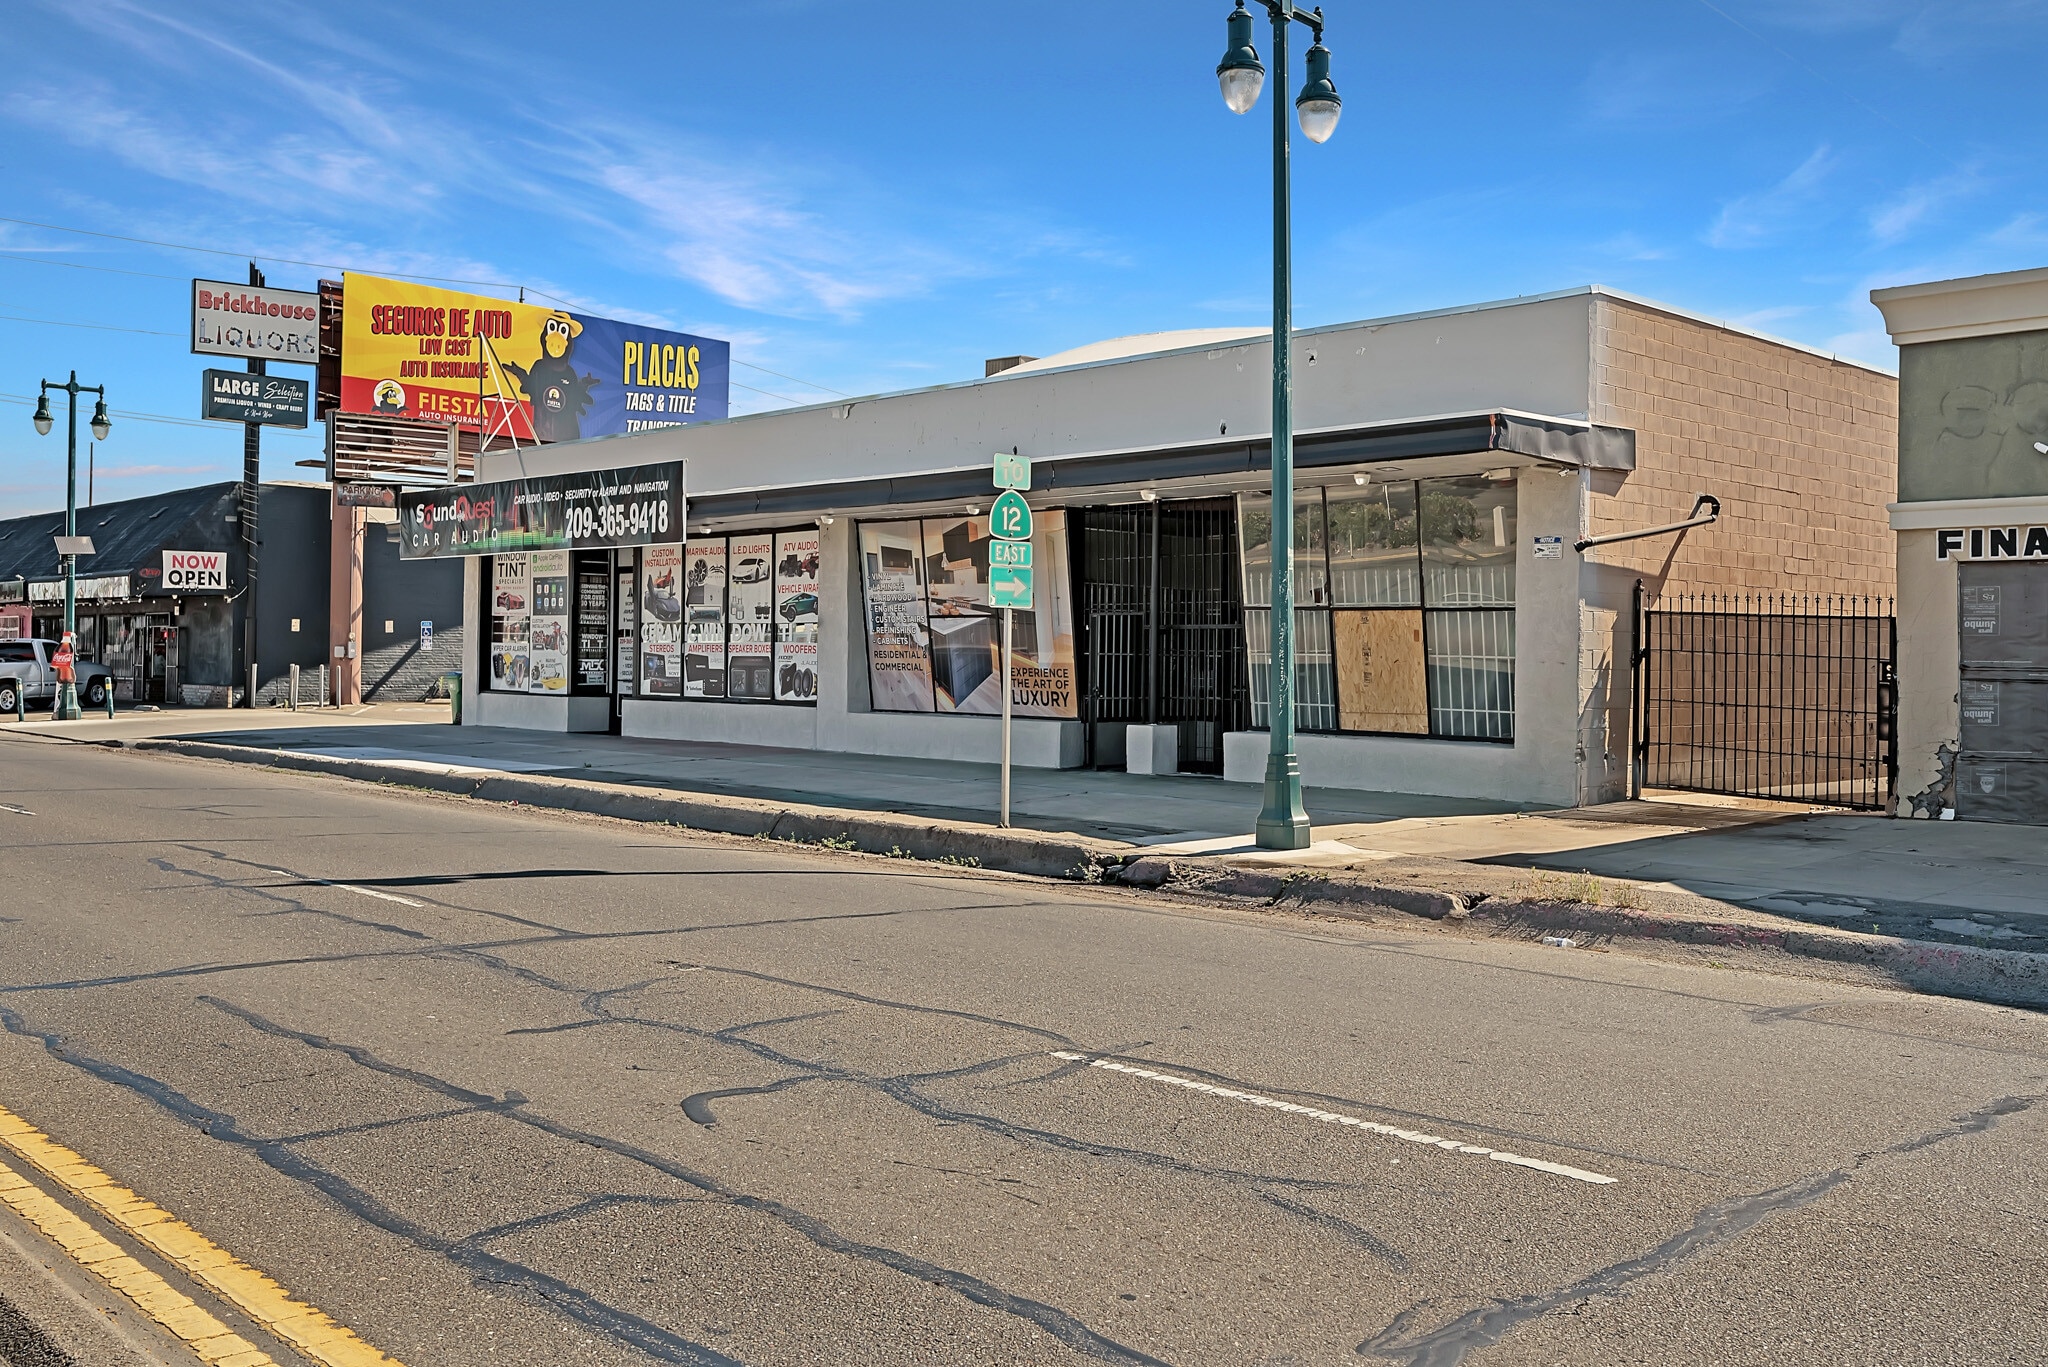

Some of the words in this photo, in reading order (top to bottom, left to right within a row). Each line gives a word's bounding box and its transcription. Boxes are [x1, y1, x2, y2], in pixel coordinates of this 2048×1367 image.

[199, 290, 316, 321] Brickhouse
[371, 305, 445, 336] SEGUROS
[449, 308, 470, 338] DE
[472, 309, 512, 340] AUTO
[199, 318, 316, 354] LIQUORS
[419, 338, 443, 355] LOW
[445, 338, 472, 356] COST
[400, 360, 428, 377] AUTO
[213, 377, 260, 397] LARGE
[263, 381, 304, 403] Selection
[214, 396, 235, 405] PREMIUM
[236, 399, 253, 407] LIQUOR
[275, 403, 289, 411] CRAFT
[418, 392, 489, 417] FIESTA
[626, 392, 654, 412] TAGS
[656, 394, 665, 412] &
[668, 394, 697, 414] TITLE
[419, 410, 441, 420] AUTO
[443, 413, 489, 426] INSURANE
[1001, 461, 1025, 483] TO
[342, 485, 382, 495] PARKING
[513, 495, 525, 505] CAR
[525, 493, 541, 504] AUDIO
[543, 491, 560, 502] VIDEO
[565, 488, 592, 500] SECURITY
[592, 490, 598, 498] or
[599, 485, 617, 497] ALARM
[619, 484, 631, 496] AND
[634, 480, 669, 494] NAVIGATION
[565, 500, 669, 539] 209-365-9418
[1002, 506, 1021, 531] 12
[412, 532, 440, 547] CAR
[451, 527, 498, 545] AUDIO
[686, 547, 708, 556] MARINE
[748, 544, 770, 554] LIGHTS
[783, 542, 797, 552] ATV
[797, 540, 818, 551] AUDIO
[497, 552, 527, 561] WINDOW
[651, 548, 675, 558] CUSTOM
[995, 543, 1027, 562] EAST
[172, 554, 218, 569] NOW
[645, 557, 681, 567] INSTALLATION
[497, 562, 527, 577] TINT
[168, 569, 221, 586] OPEN
[777, 584, 802, 594] VEHICLE
[872, 583, 905, 591] LAMINATE
[873, 593, 912, 602] HARDWOOD
[874, 605, 907, 613] ENGINEER
[903, 615, 925, 623] STAIRS
[1964, 620, 1996, 630] Jumbo
[876, 627, 916, 635] REFINISHING
[877, 637, 908, 645] CABINETS
[649, 644, 675, 653] STEREOS
[688, 644, 723, 653] AMPLIFIERS
[728, 644, 753, 653] SPEAKER
[783, 644, 817, 654] WOOFERS
[874, 650, 920, 659] RESIDENTIAL
[922, 650, 927, 659] &
[875, 662, 923, 671] COMMERCIAL
[1011, 667, 1069, 678] EXPERIENCE
[1011, 678, 1030, 688] THE
[1033, 679, 1052, 689] ART
[1055, 680, 1069, 689] OF
[1012, 689, 1070, 707] LUXURY
[1963, 710, 1995, 720] Jumbo
